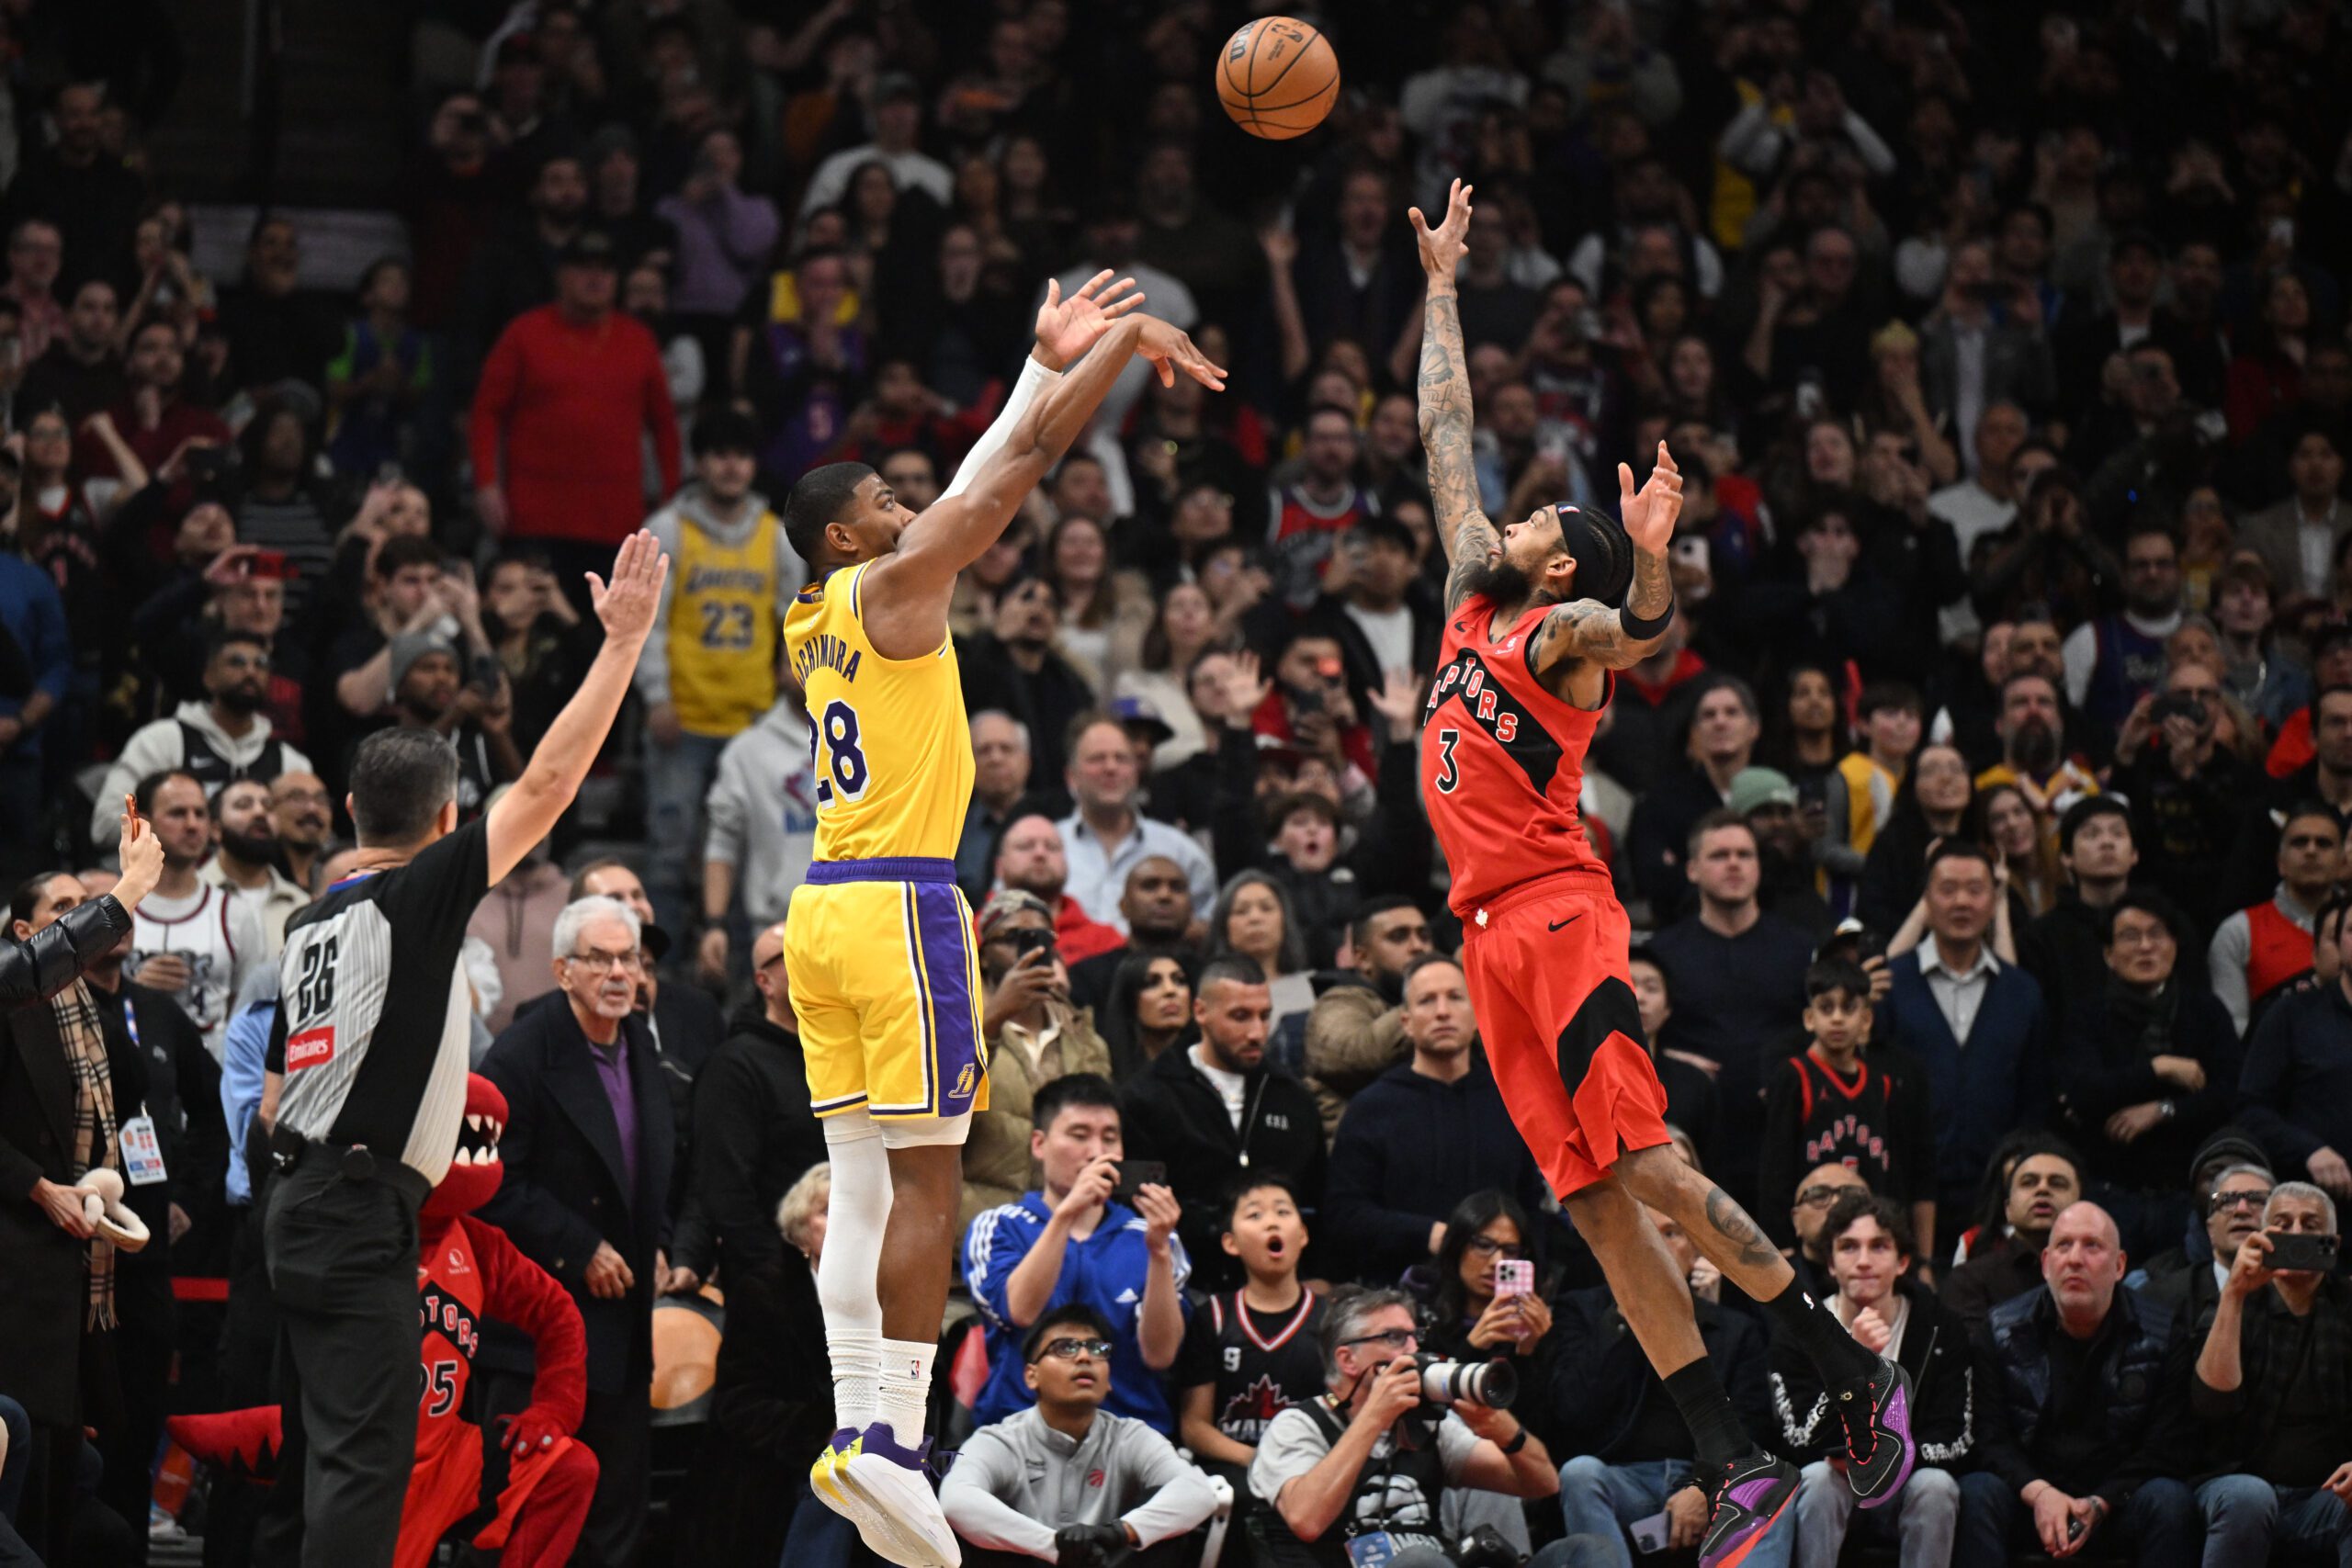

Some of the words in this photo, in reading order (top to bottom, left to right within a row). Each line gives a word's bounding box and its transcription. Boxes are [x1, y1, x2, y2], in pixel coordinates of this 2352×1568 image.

[701, 602, 755, 648] 23
[1424, 657, 1519, 742] APTORS
[1435, 729, 1460, 794] 3
[298, 935, 337, 1022] 26
[288, 1037, 329, 1064] Emirates
[1223, 1347, 1241, 1372] 9
